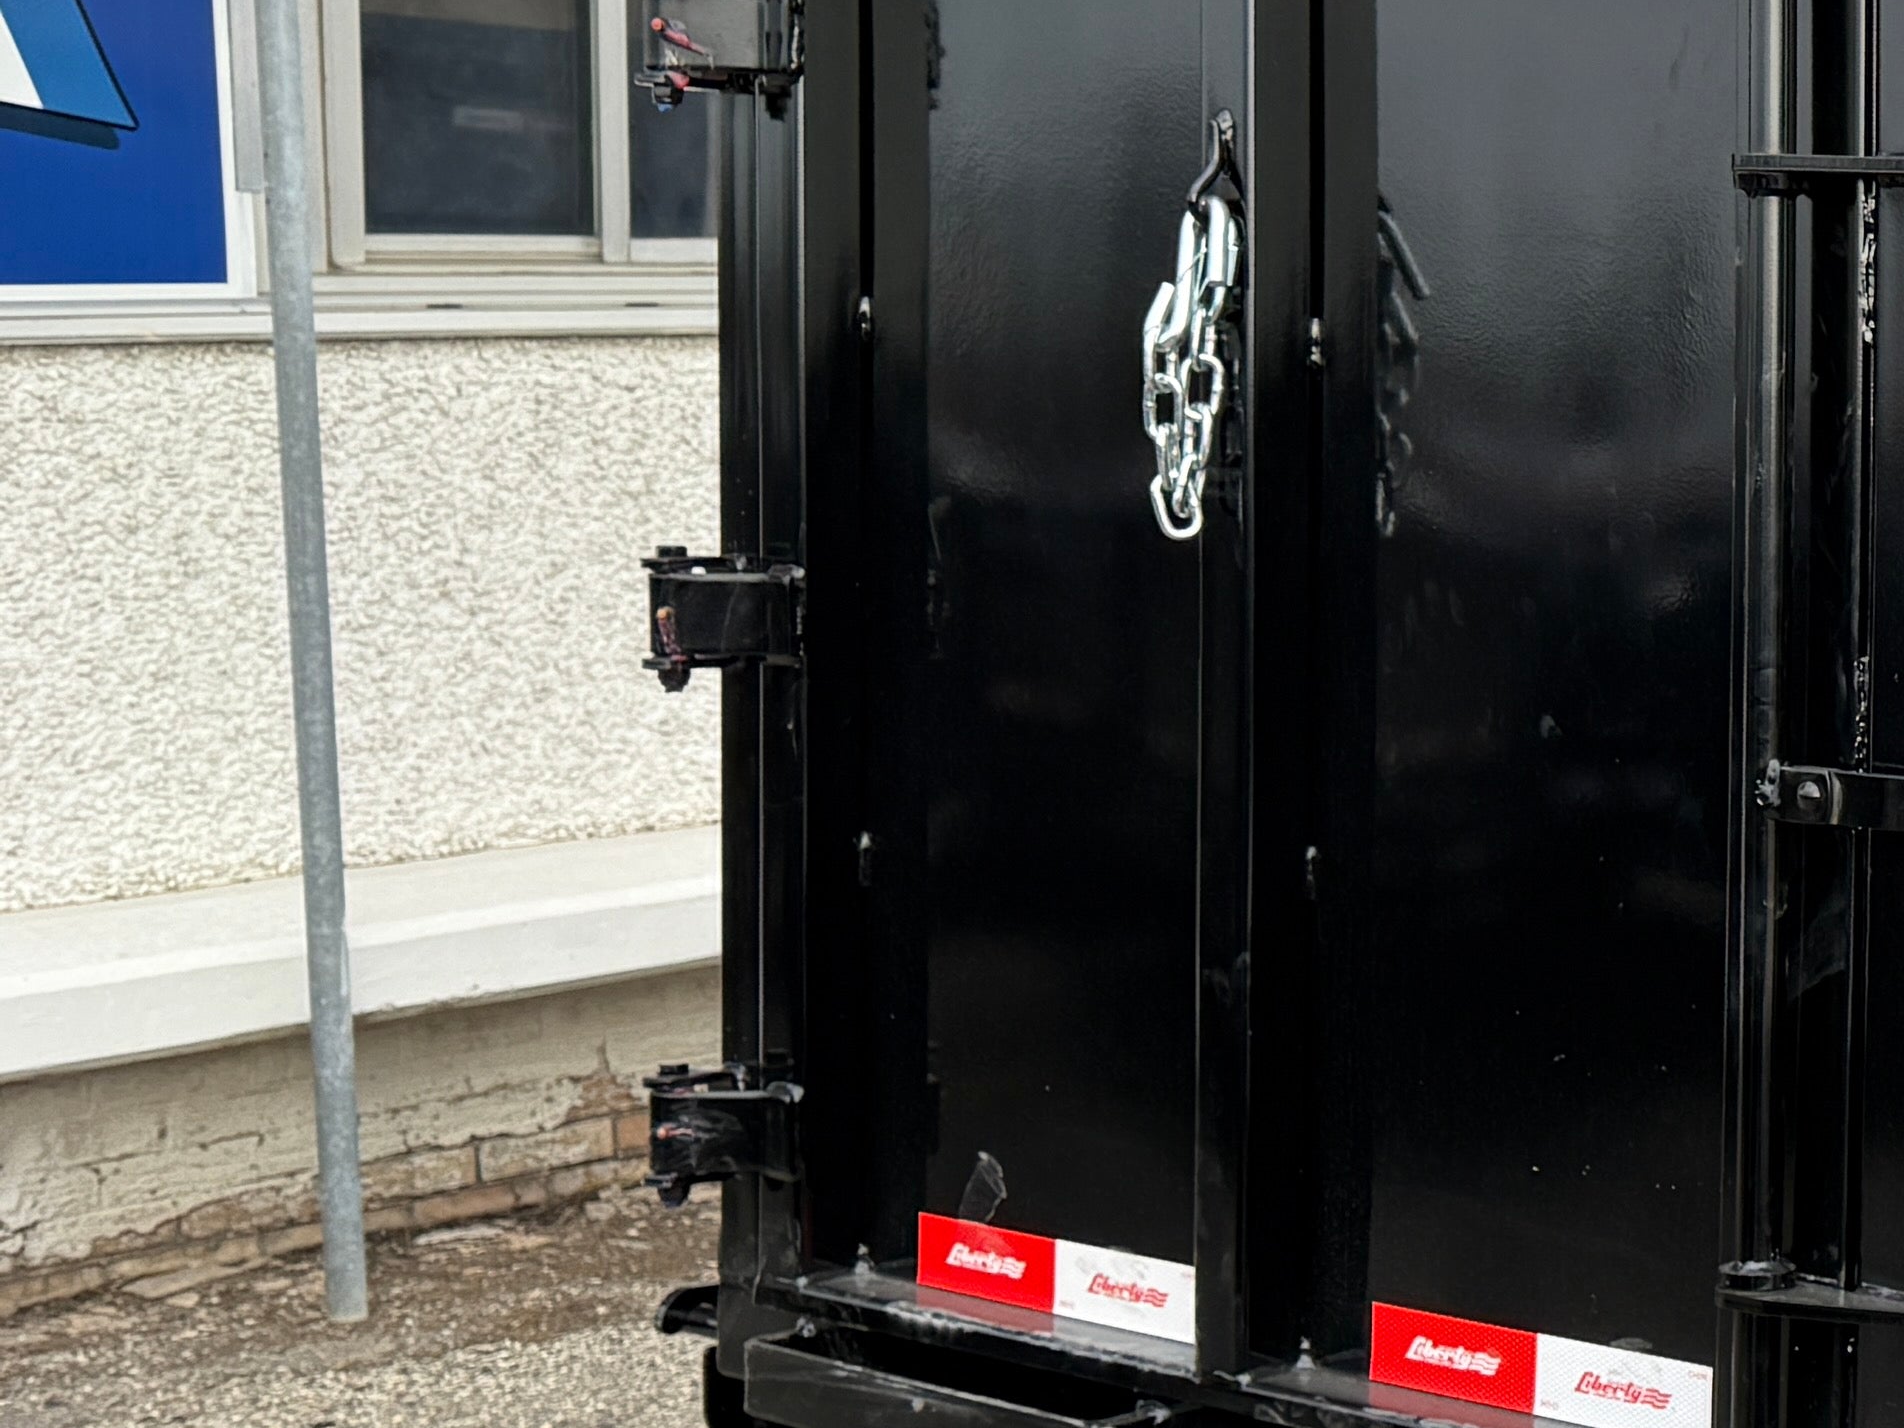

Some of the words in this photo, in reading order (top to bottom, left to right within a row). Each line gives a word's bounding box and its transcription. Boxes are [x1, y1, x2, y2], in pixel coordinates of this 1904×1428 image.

[945, 1241, 1002, 1275] Liberty
[1087, 1271, 1144, 1303] Liberty
[1404, 1334, 1473, 1371] Liberty
[1573, 1371, 1643, 1403] Liberty
